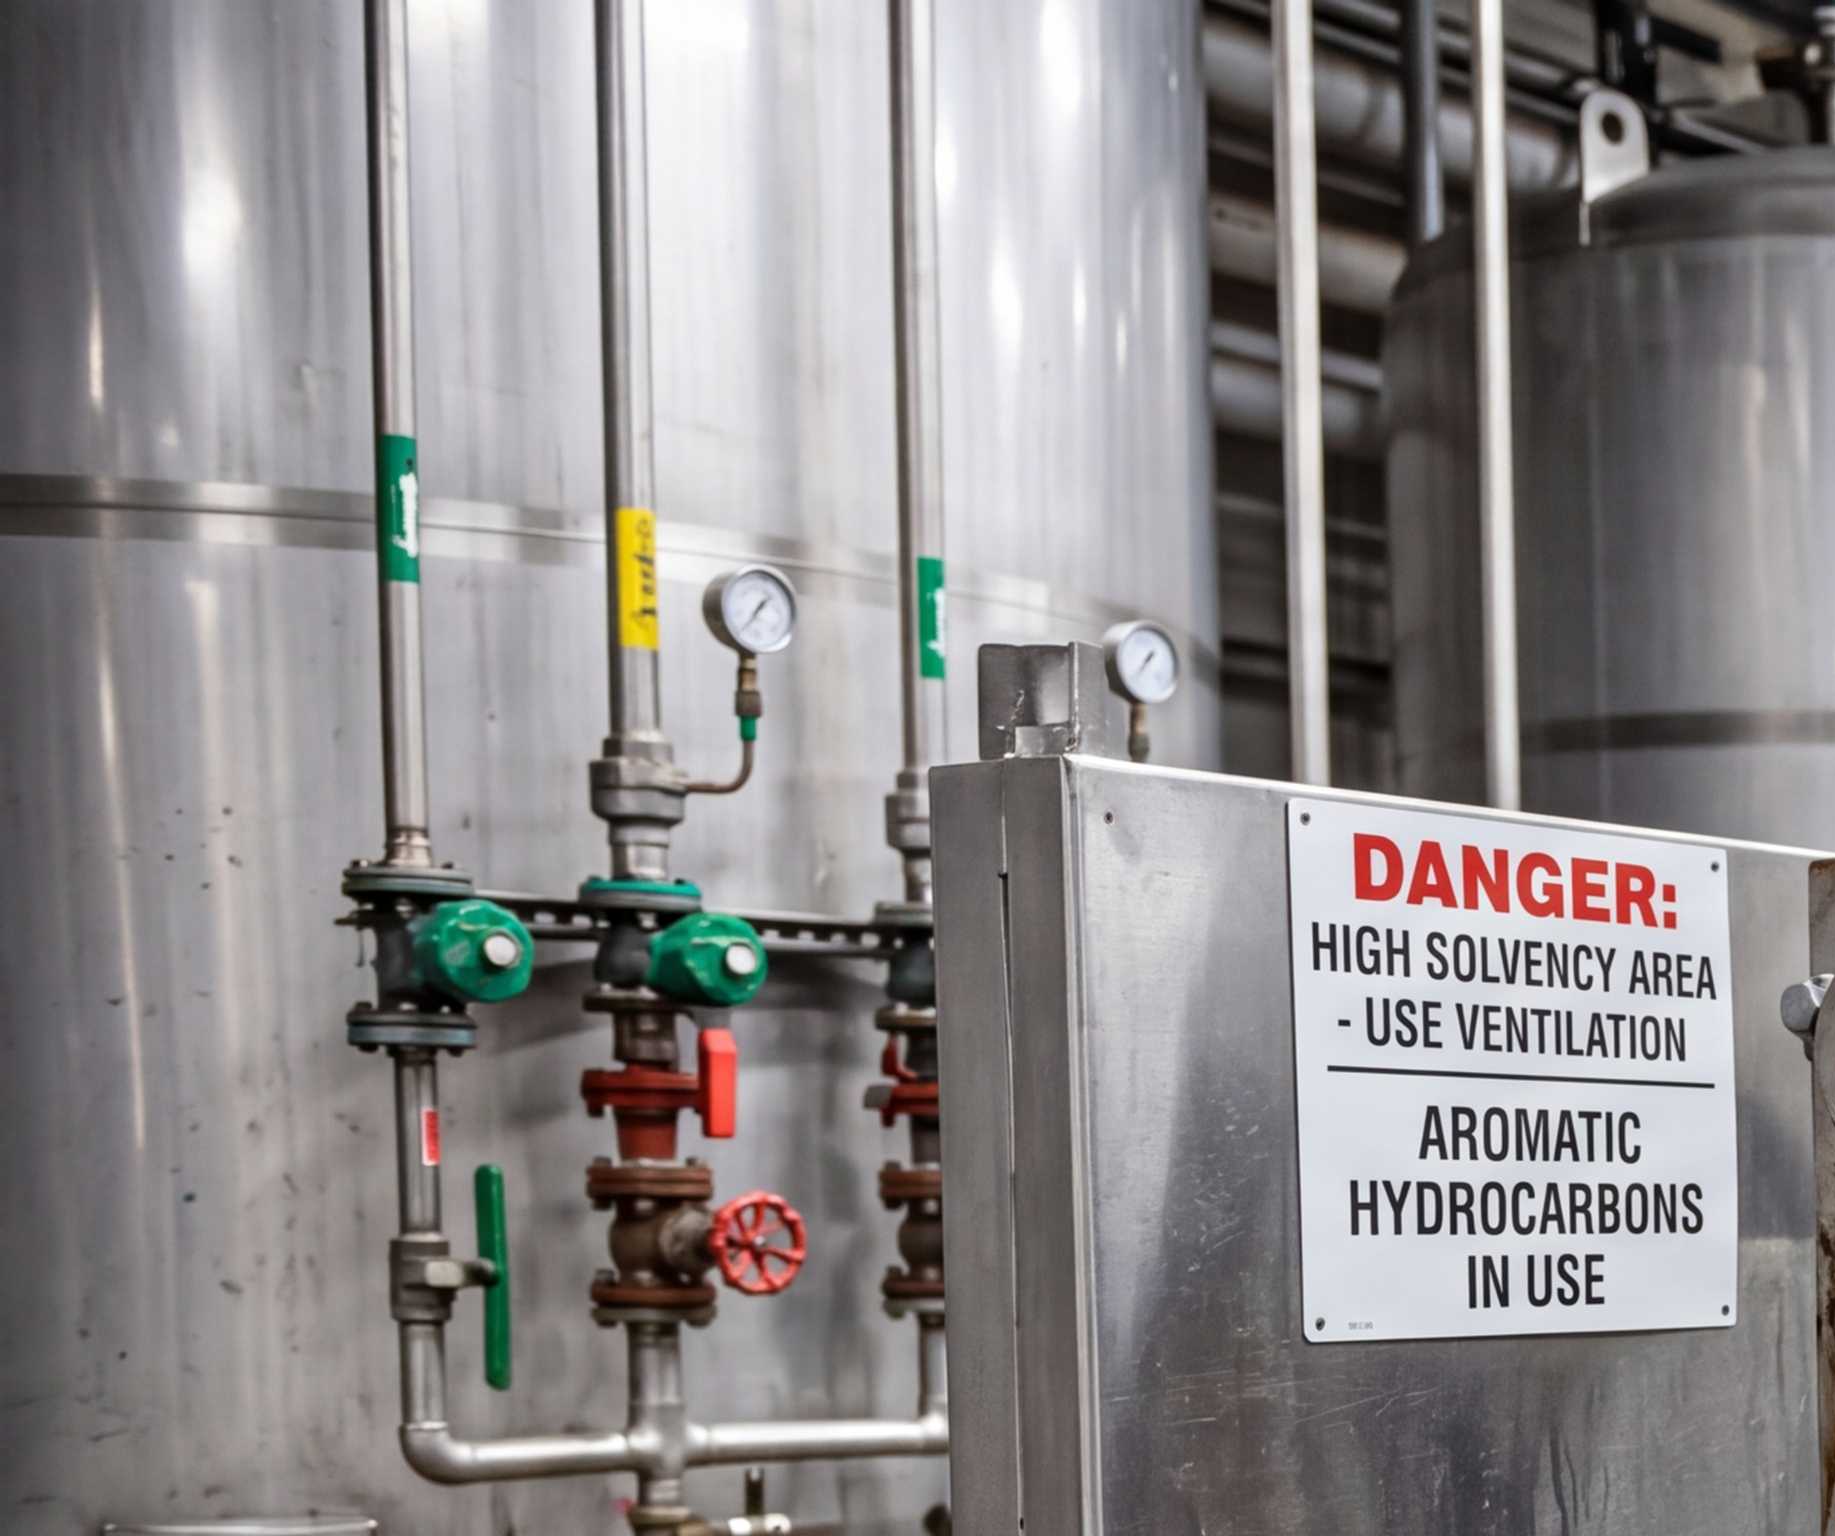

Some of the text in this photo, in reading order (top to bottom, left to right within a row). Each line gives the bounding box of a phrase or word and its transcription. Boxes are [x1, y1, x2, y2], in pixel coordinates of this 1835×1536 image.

[1353, 832, 1677, 930] DANGER:
[1311, 921, 1717, 1001] HIGH SOLVENCY AREA
[1337, 996, 1686, 1062] - USE VENTILATION
[1418, 1105, 1642, 1165] AROMATIC
[1349, 1179, 1704, 1236] HYDROCARBONS
[1467, 1253, 1606, 1310] IN USE
